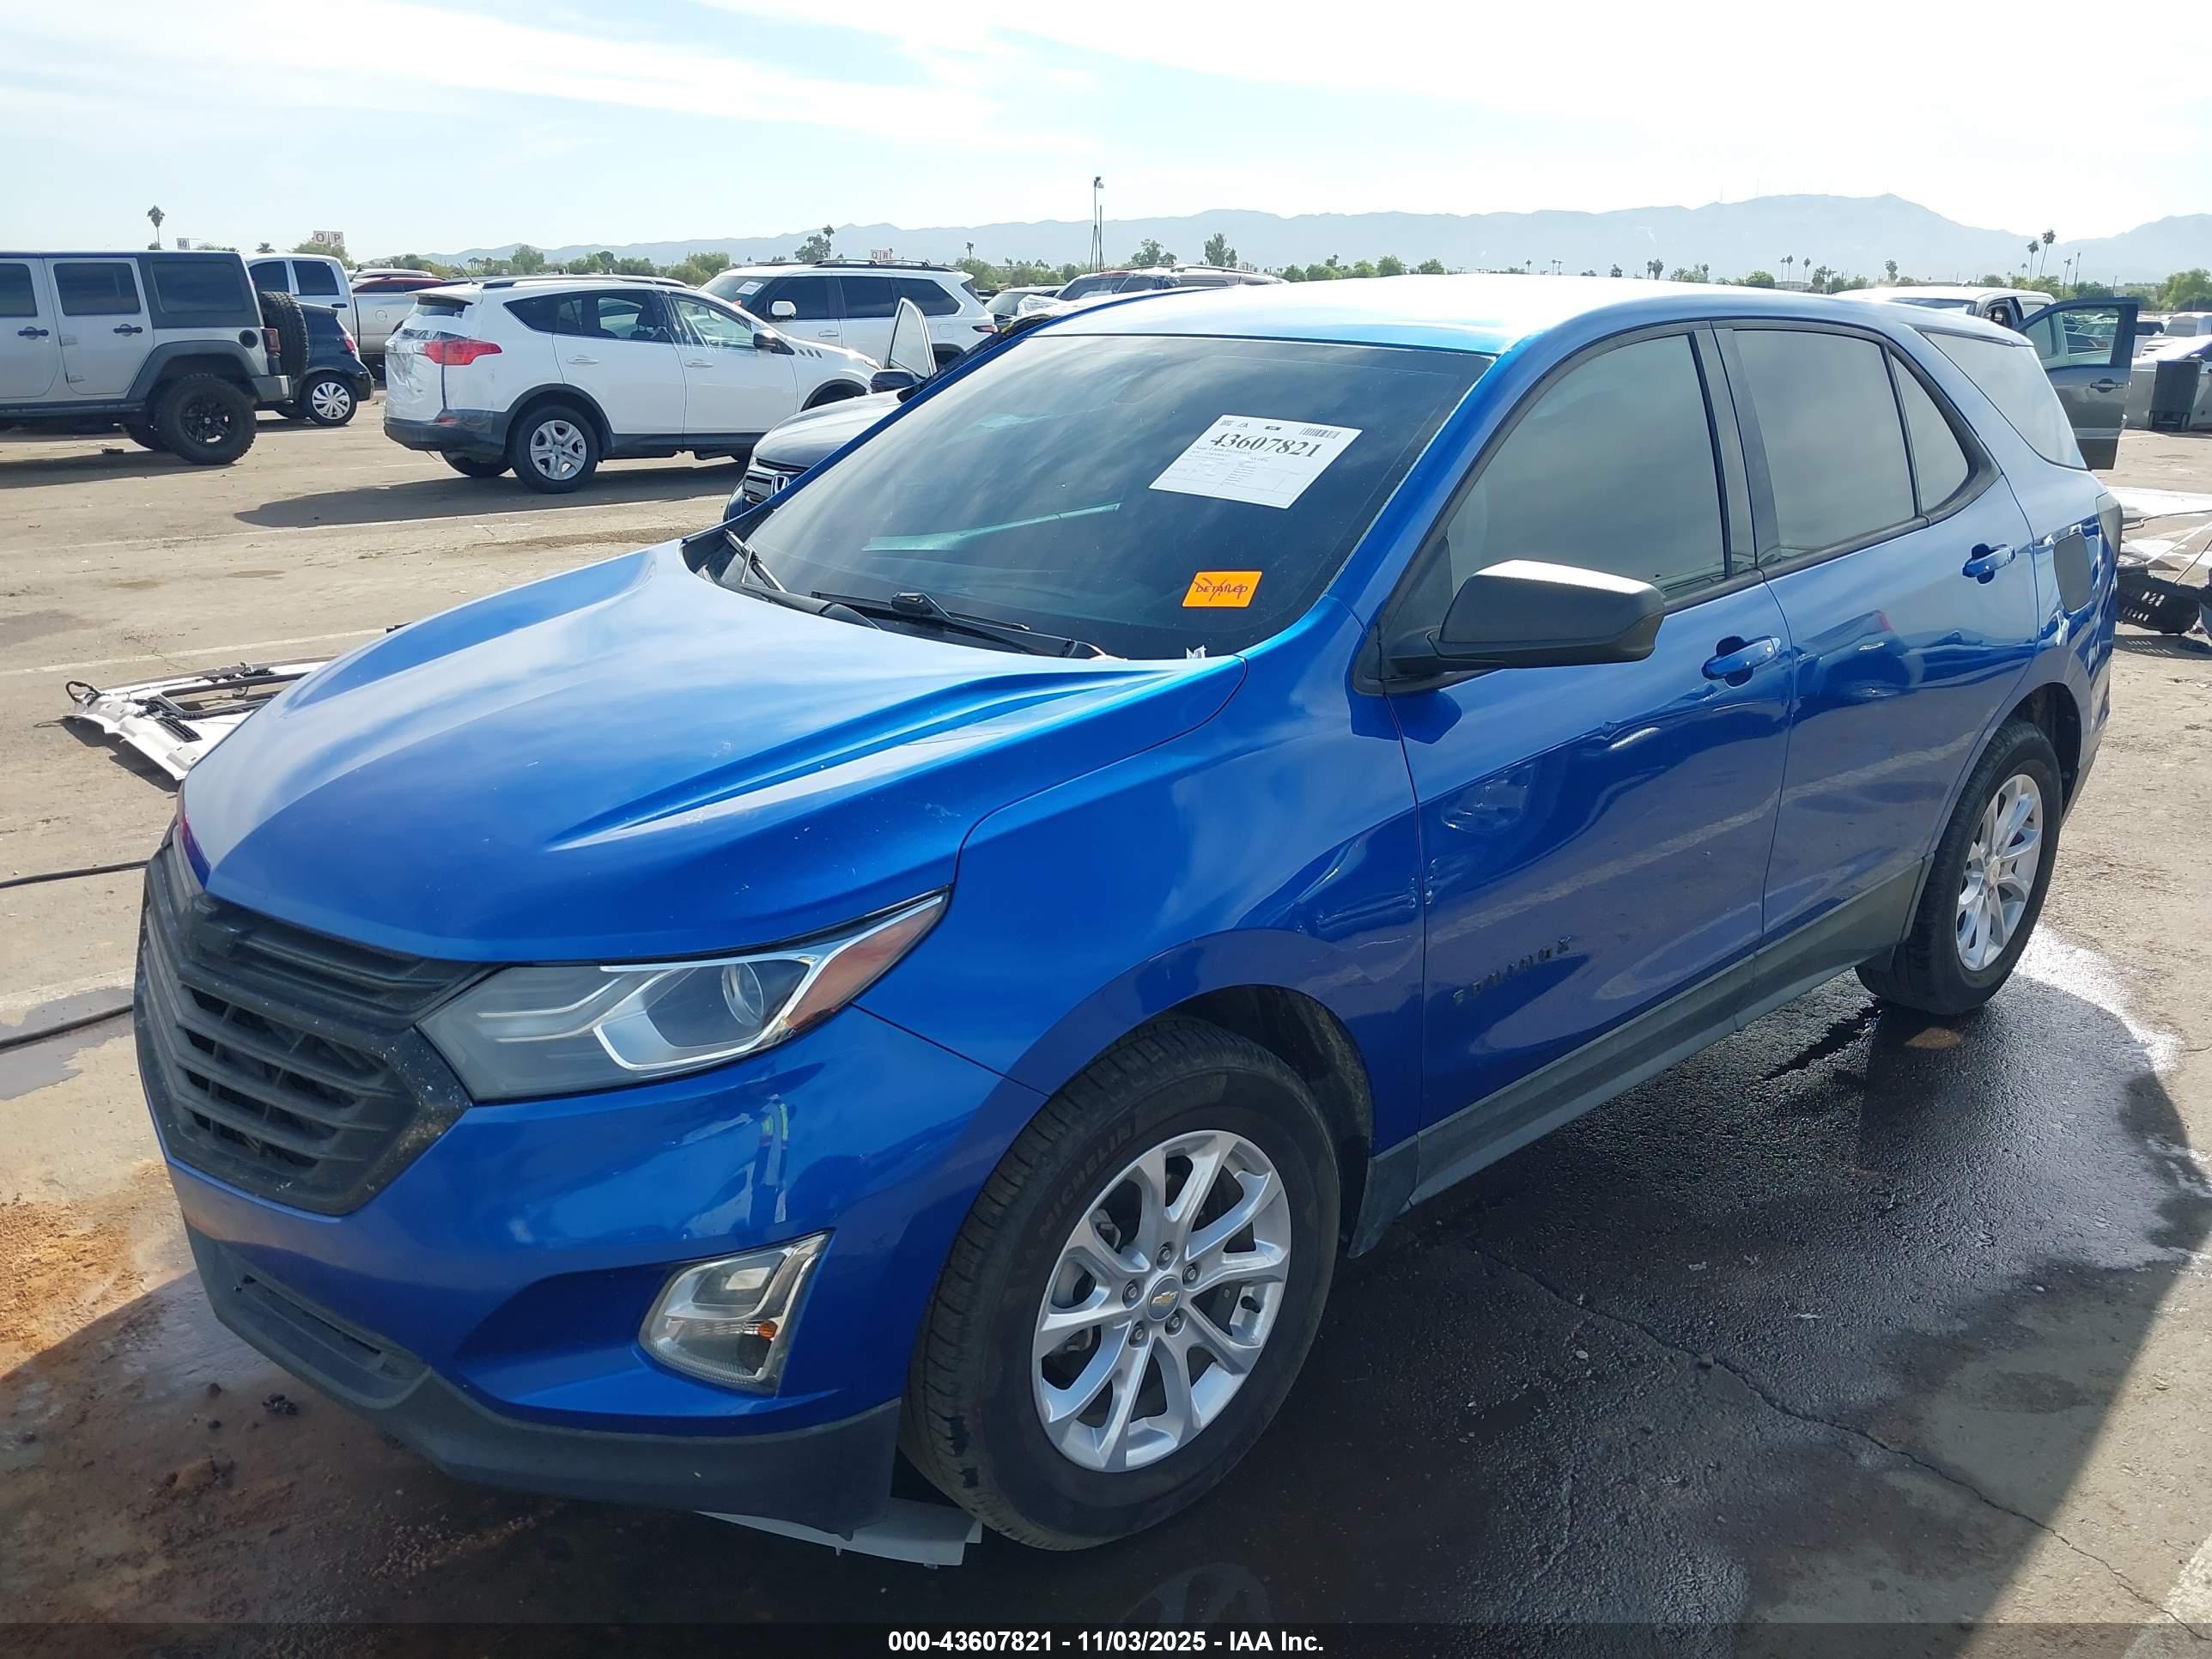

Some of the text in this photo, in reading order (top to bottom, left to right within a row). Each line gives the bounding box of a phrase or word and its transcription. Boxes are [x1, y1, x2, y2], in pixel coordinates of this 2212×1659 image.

[315, 233, 325, 242] O
[177, 240, 187, 248] 40
[1210, 432, 1322, 458] 43607821
